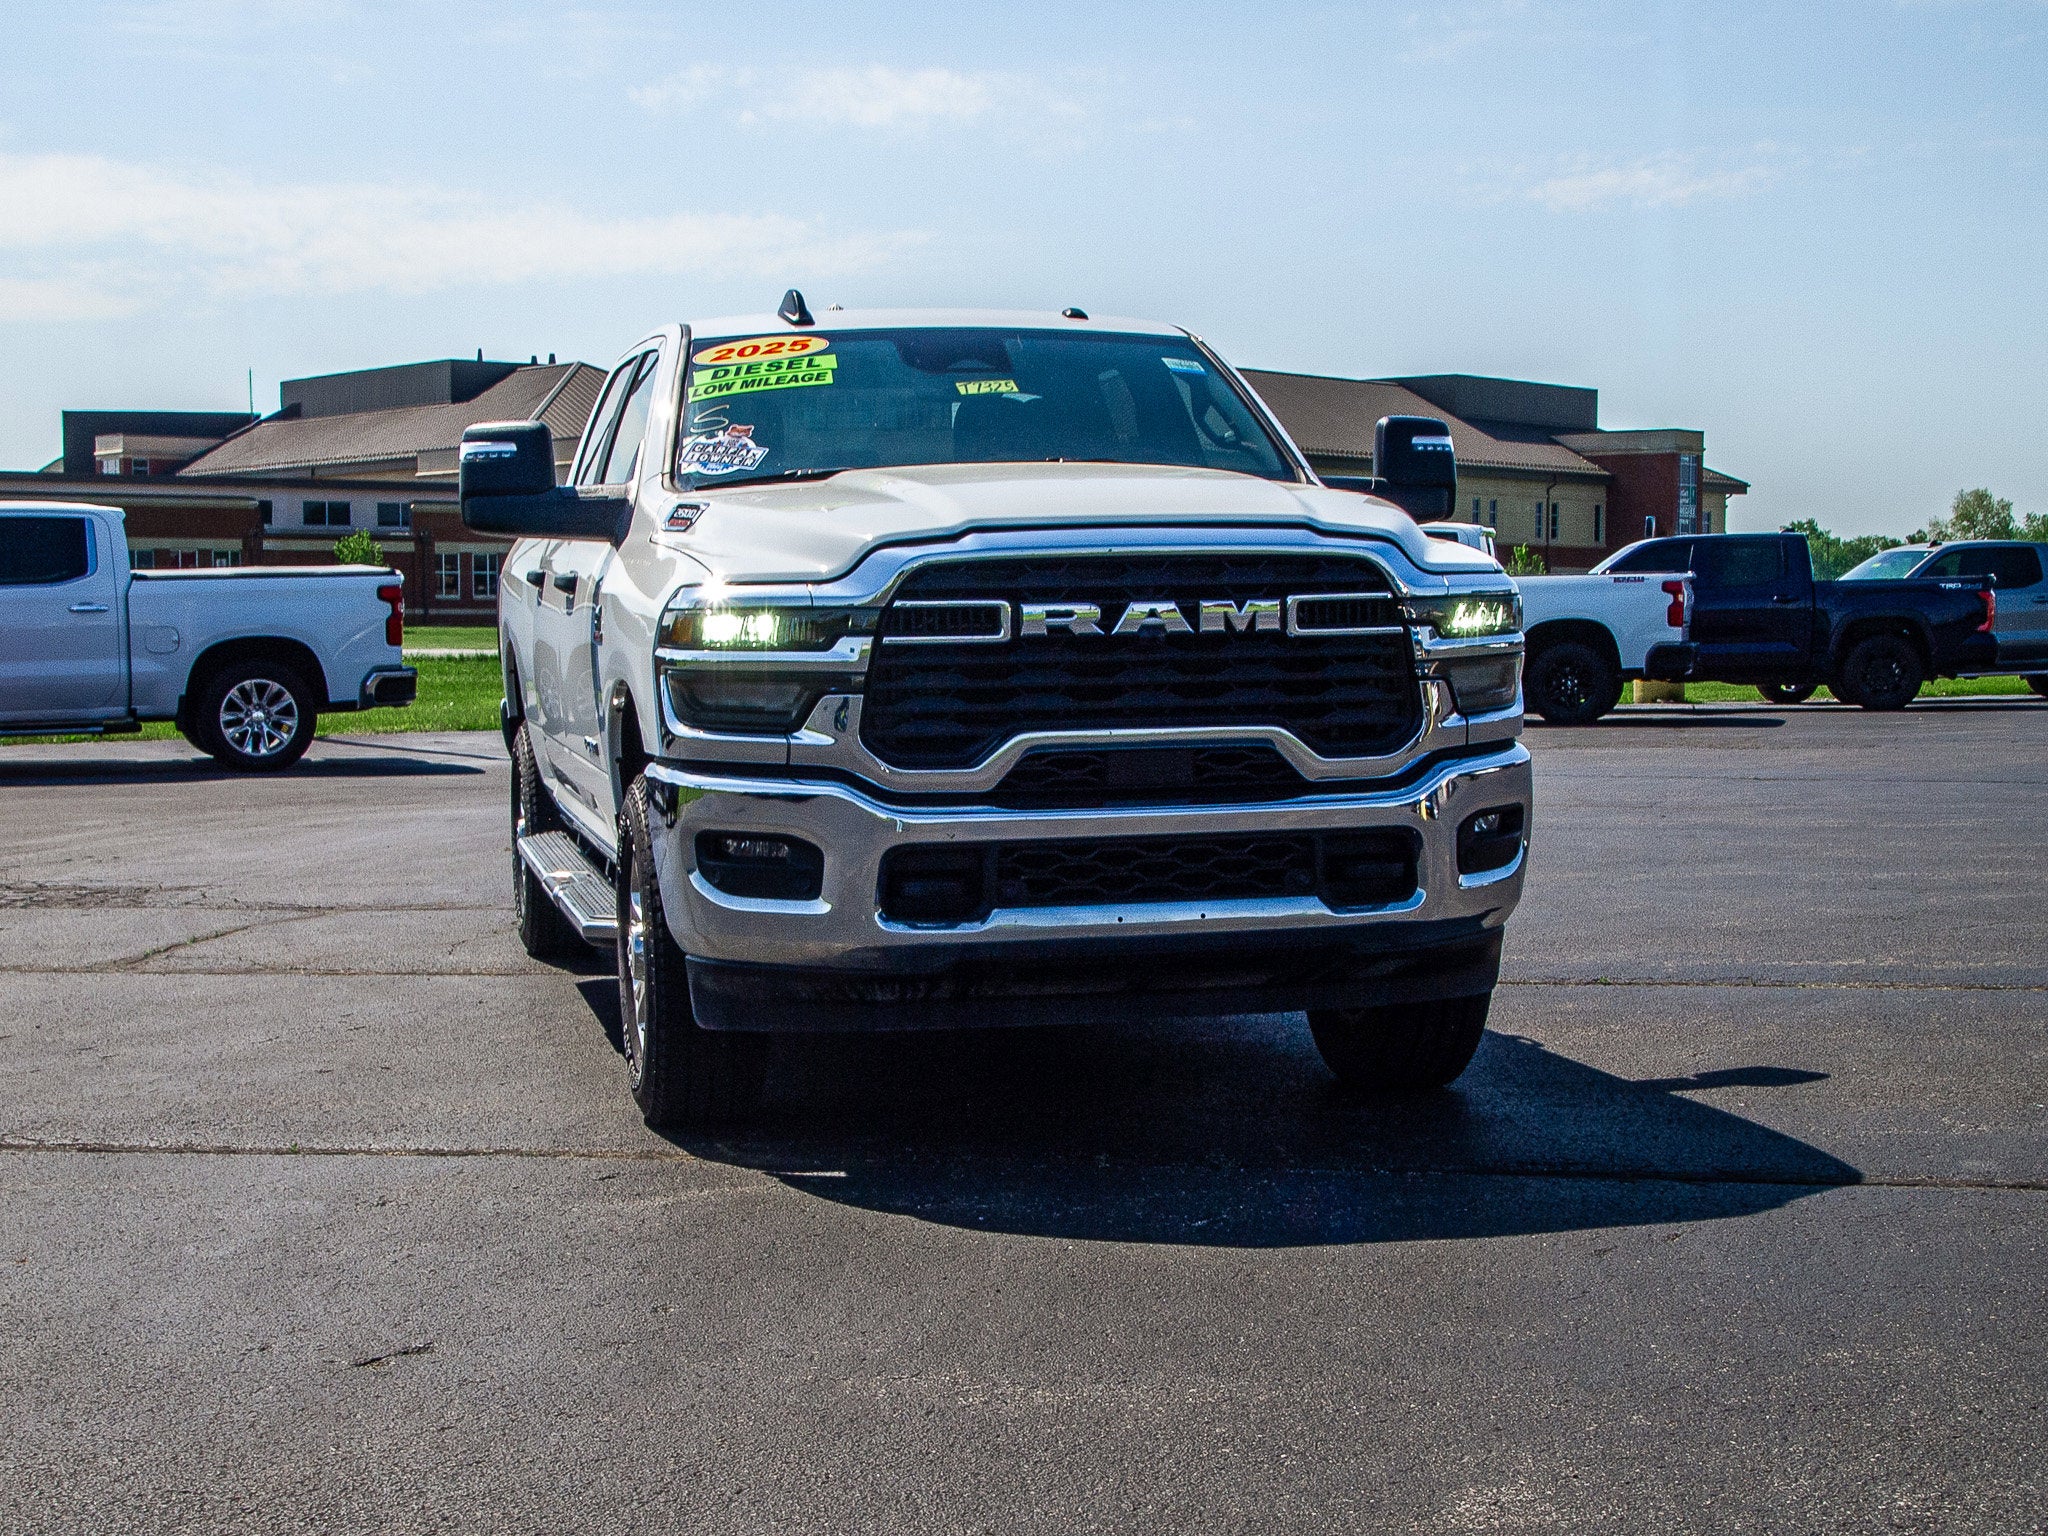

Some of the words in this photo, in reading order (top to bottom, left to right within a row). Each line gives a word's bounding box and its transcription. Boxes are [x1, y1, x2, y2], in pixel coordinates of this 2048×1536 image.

[710, 338, 812, 362] 2025
[711, 357, 822, 381] DIESEL
[692, 381, 736, 398] LOW
[740, 371, 829, 390] MILEAGE
[1020, 600, 1282, 636] RAM
